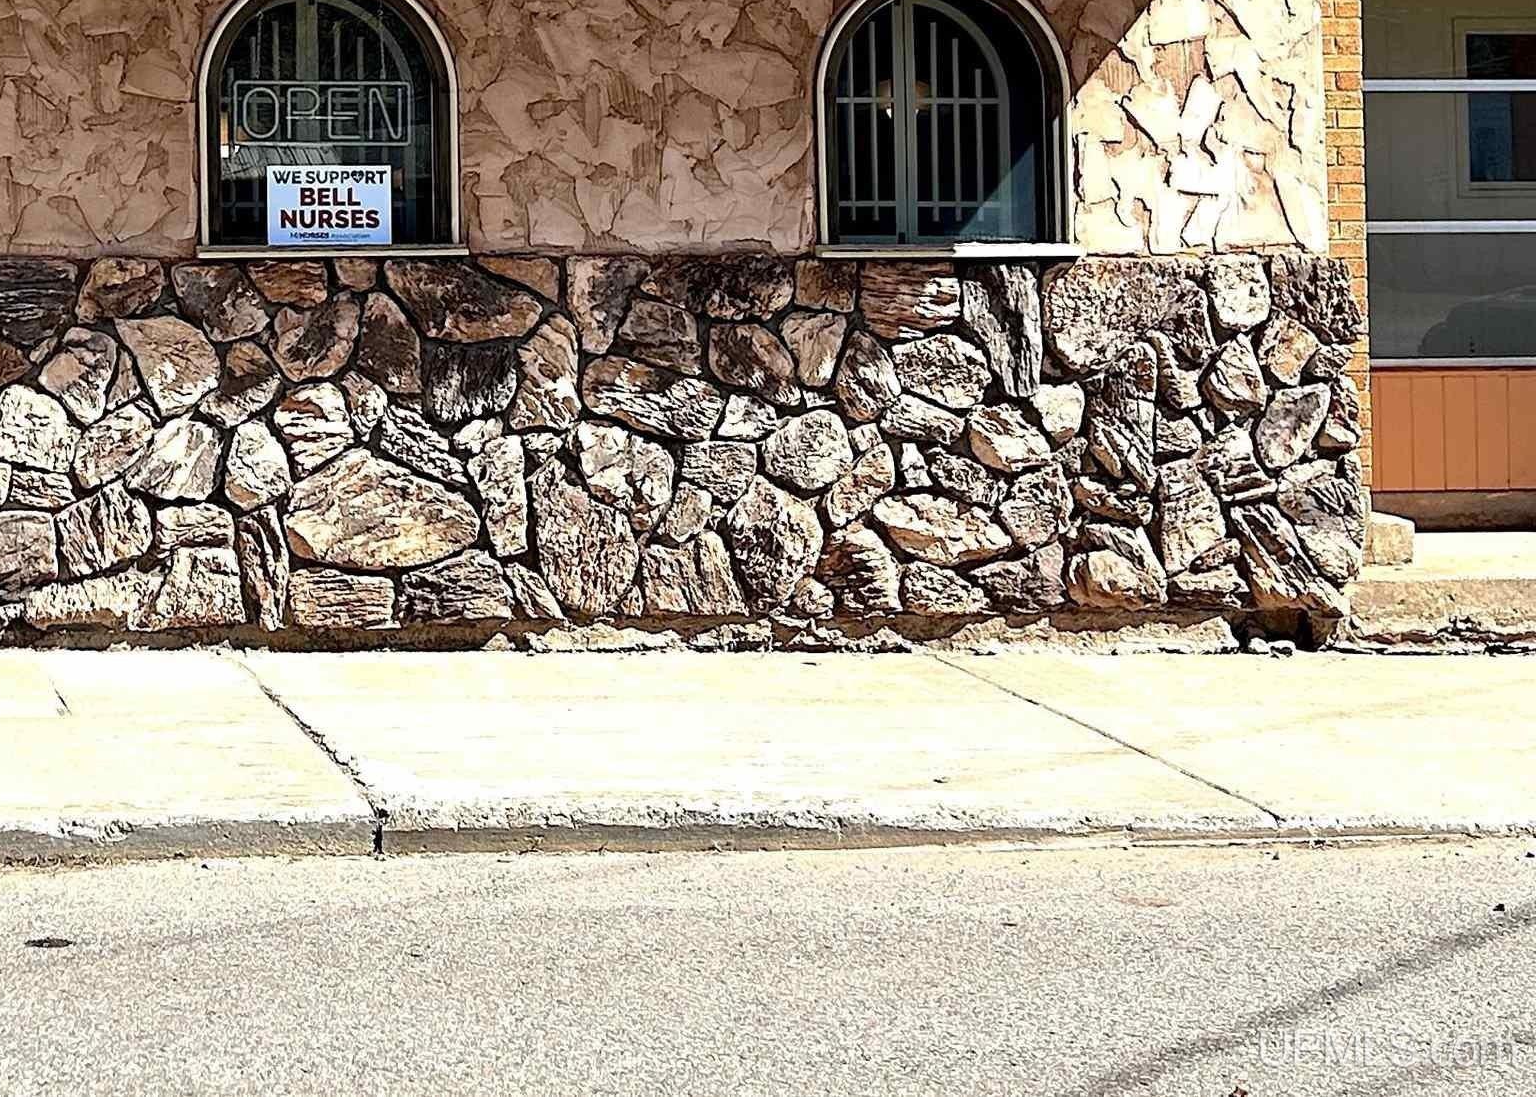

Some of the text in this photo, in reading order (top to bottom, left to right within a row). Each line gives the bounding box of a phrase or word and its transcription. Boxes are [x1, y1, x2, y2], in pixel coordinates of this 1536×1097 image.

[242, 86, 402, 140] OPEN
[272, 170, 302, 184] WE
[300, 187, 362, 207] BELL
[280, 209, 381, 229] NURSES
